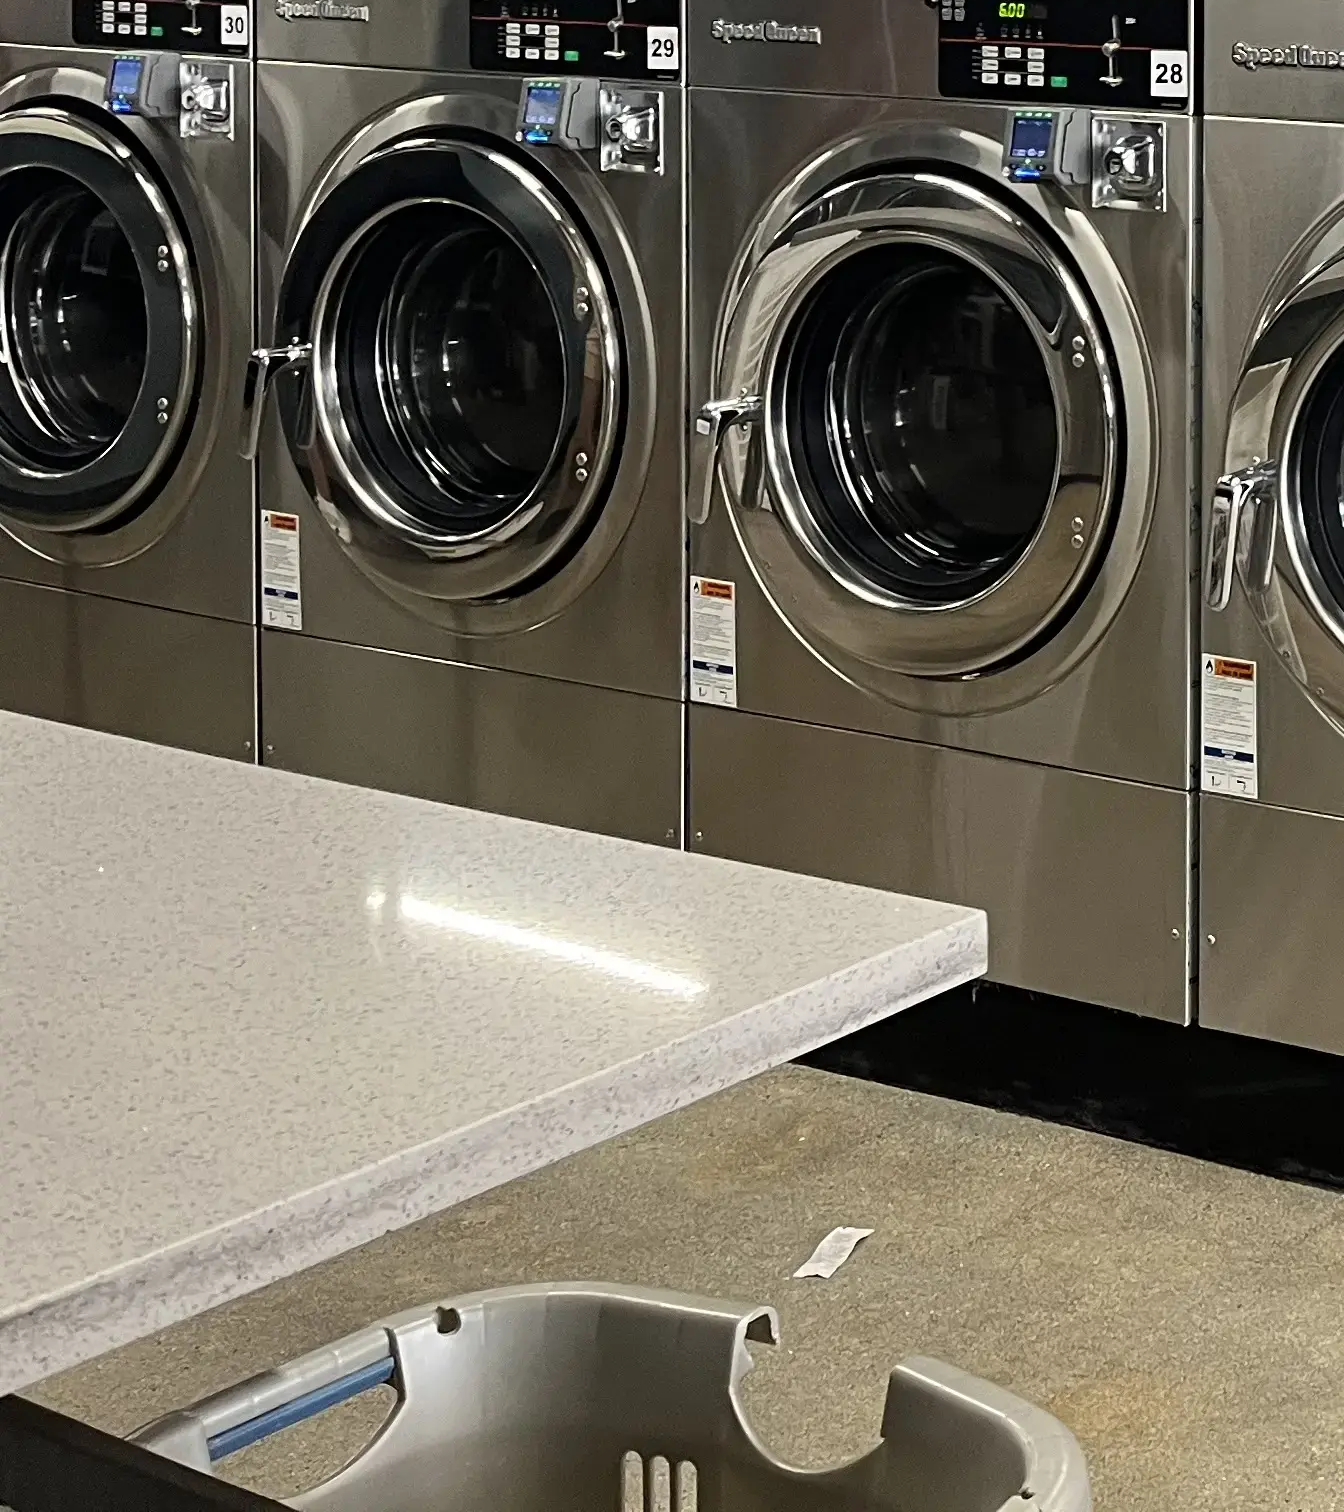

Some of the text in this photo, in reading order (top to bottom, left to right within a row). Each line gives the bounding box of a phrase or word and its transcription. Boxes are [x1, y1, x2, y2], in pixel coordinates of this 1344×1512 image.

[225, 17, 244, 34] 30
[711, 18, 764, 44] Speed
[651, 39, 674, 58] 29
[1232, 42, 1298, 71] Speed
[1155, 63, 1183, 84] 28
